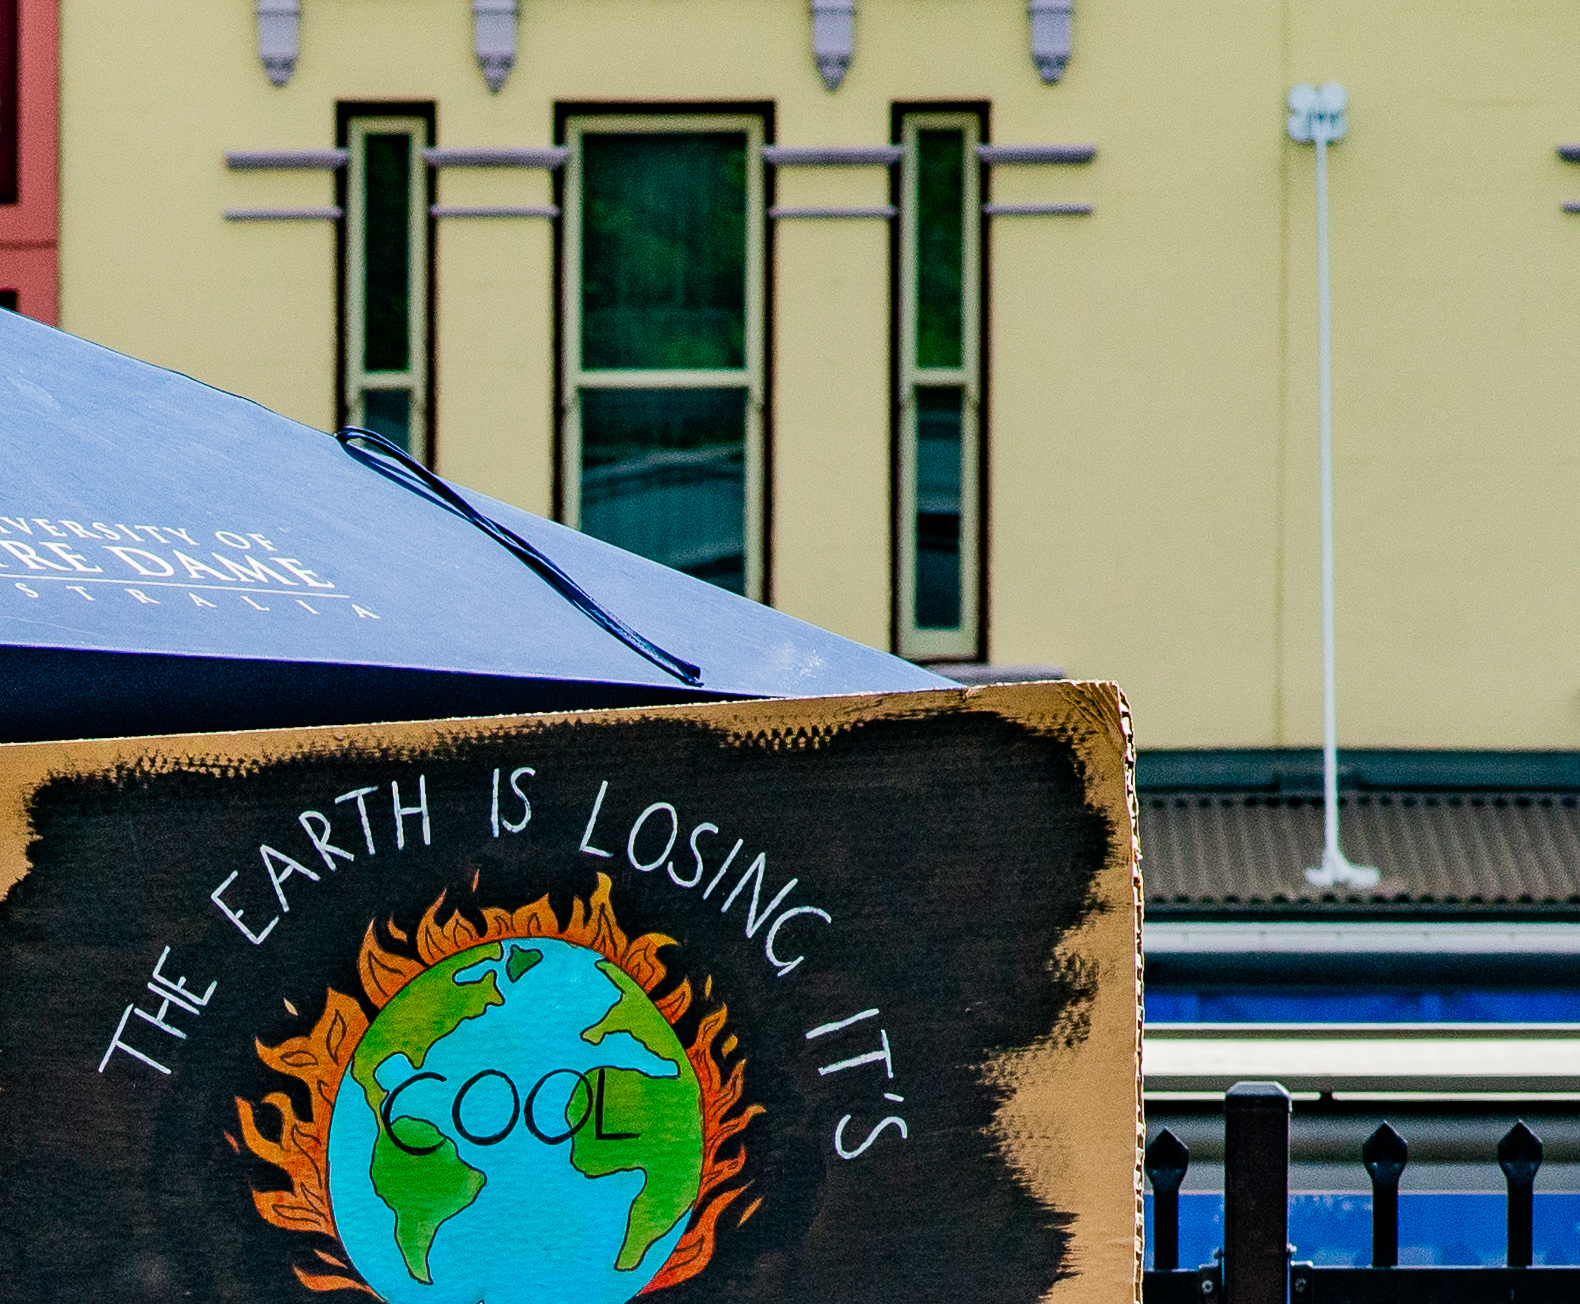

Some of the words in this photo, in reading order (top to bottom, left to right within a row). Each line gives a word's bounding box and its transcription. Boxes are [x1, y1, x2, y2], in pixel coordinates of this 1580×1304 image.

[102, 545, 336, 588] DAME
[213, 530, 279, 554] OF
[98, 944, 218, 1075] THE
[211, 773, 432, 947] EARTH
[490, 766, 536, 838] IS
[579, 779, 833, 978] LOSING
[804, 1006, 909, 1162] IT'S
[381, 1064, 640, 1156] COOL
